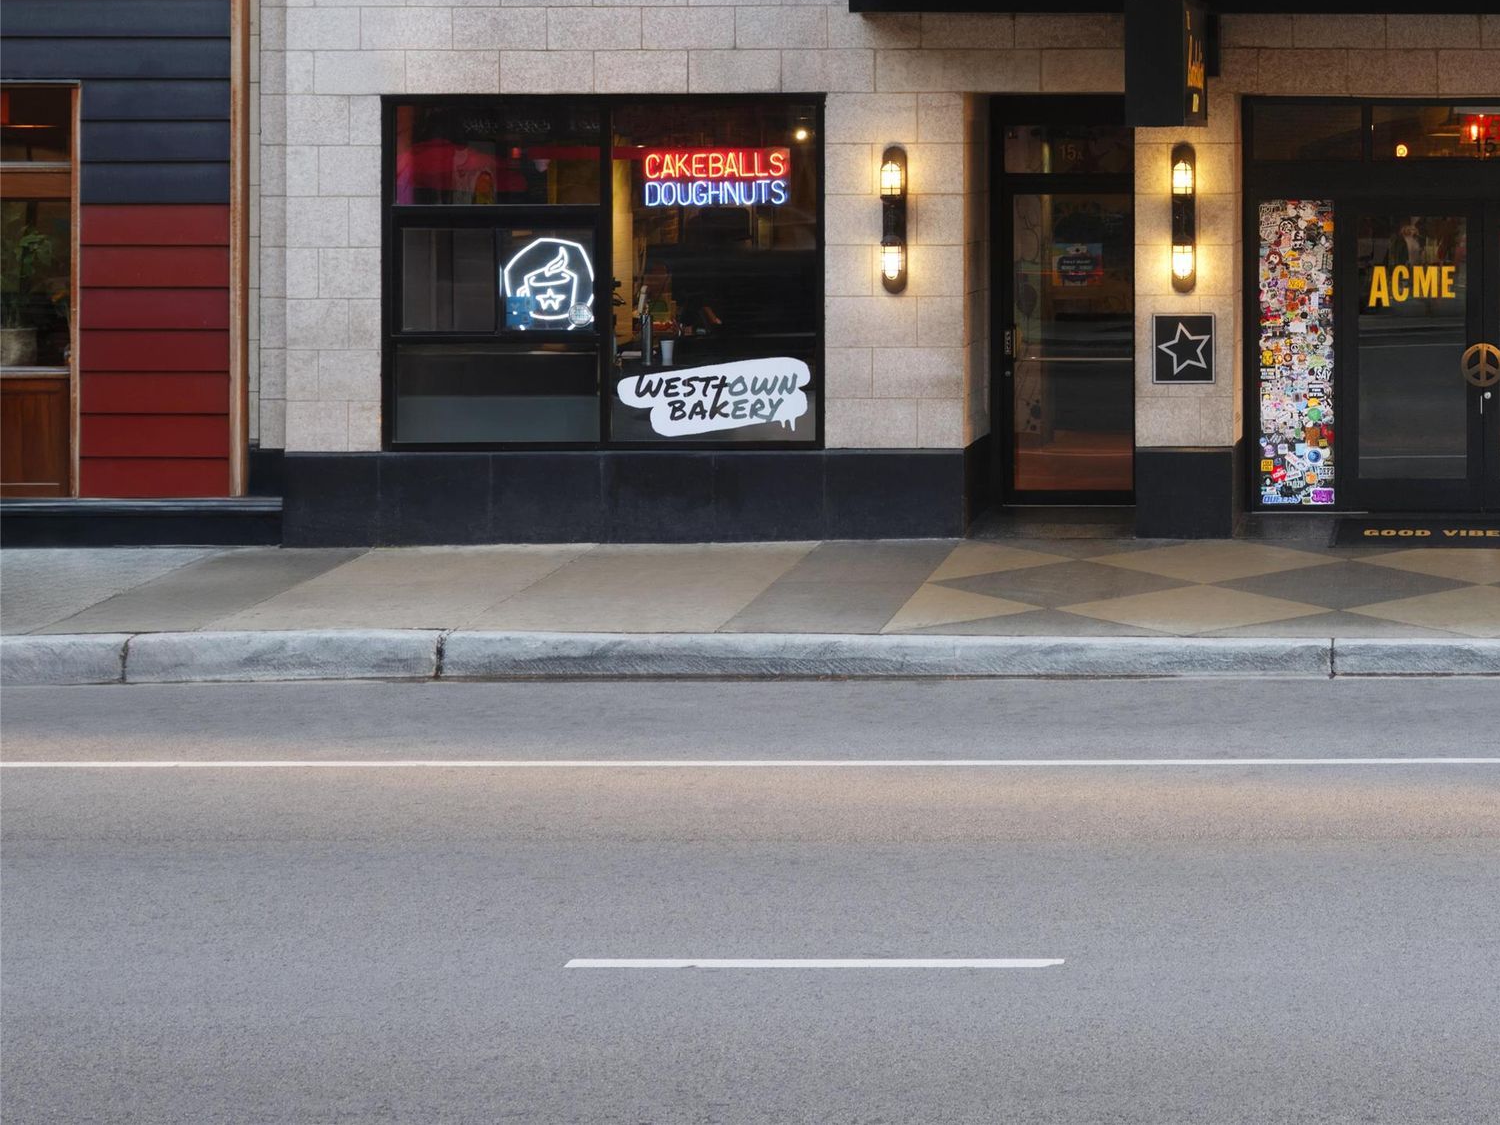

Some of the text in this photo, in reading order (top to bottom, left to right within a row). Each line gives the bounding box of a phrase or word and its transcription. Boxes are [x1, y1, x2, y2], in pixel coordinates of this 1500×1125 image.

[644, 151, 786, 179] CAKEBALLS
[644, 180, 787, 207] DOUGHNUTS
[1368, 265, 1456, 308] ACME
[667, 397, 784, 422] BAKERY
[1363, 529, 1432, 537] GOOD
